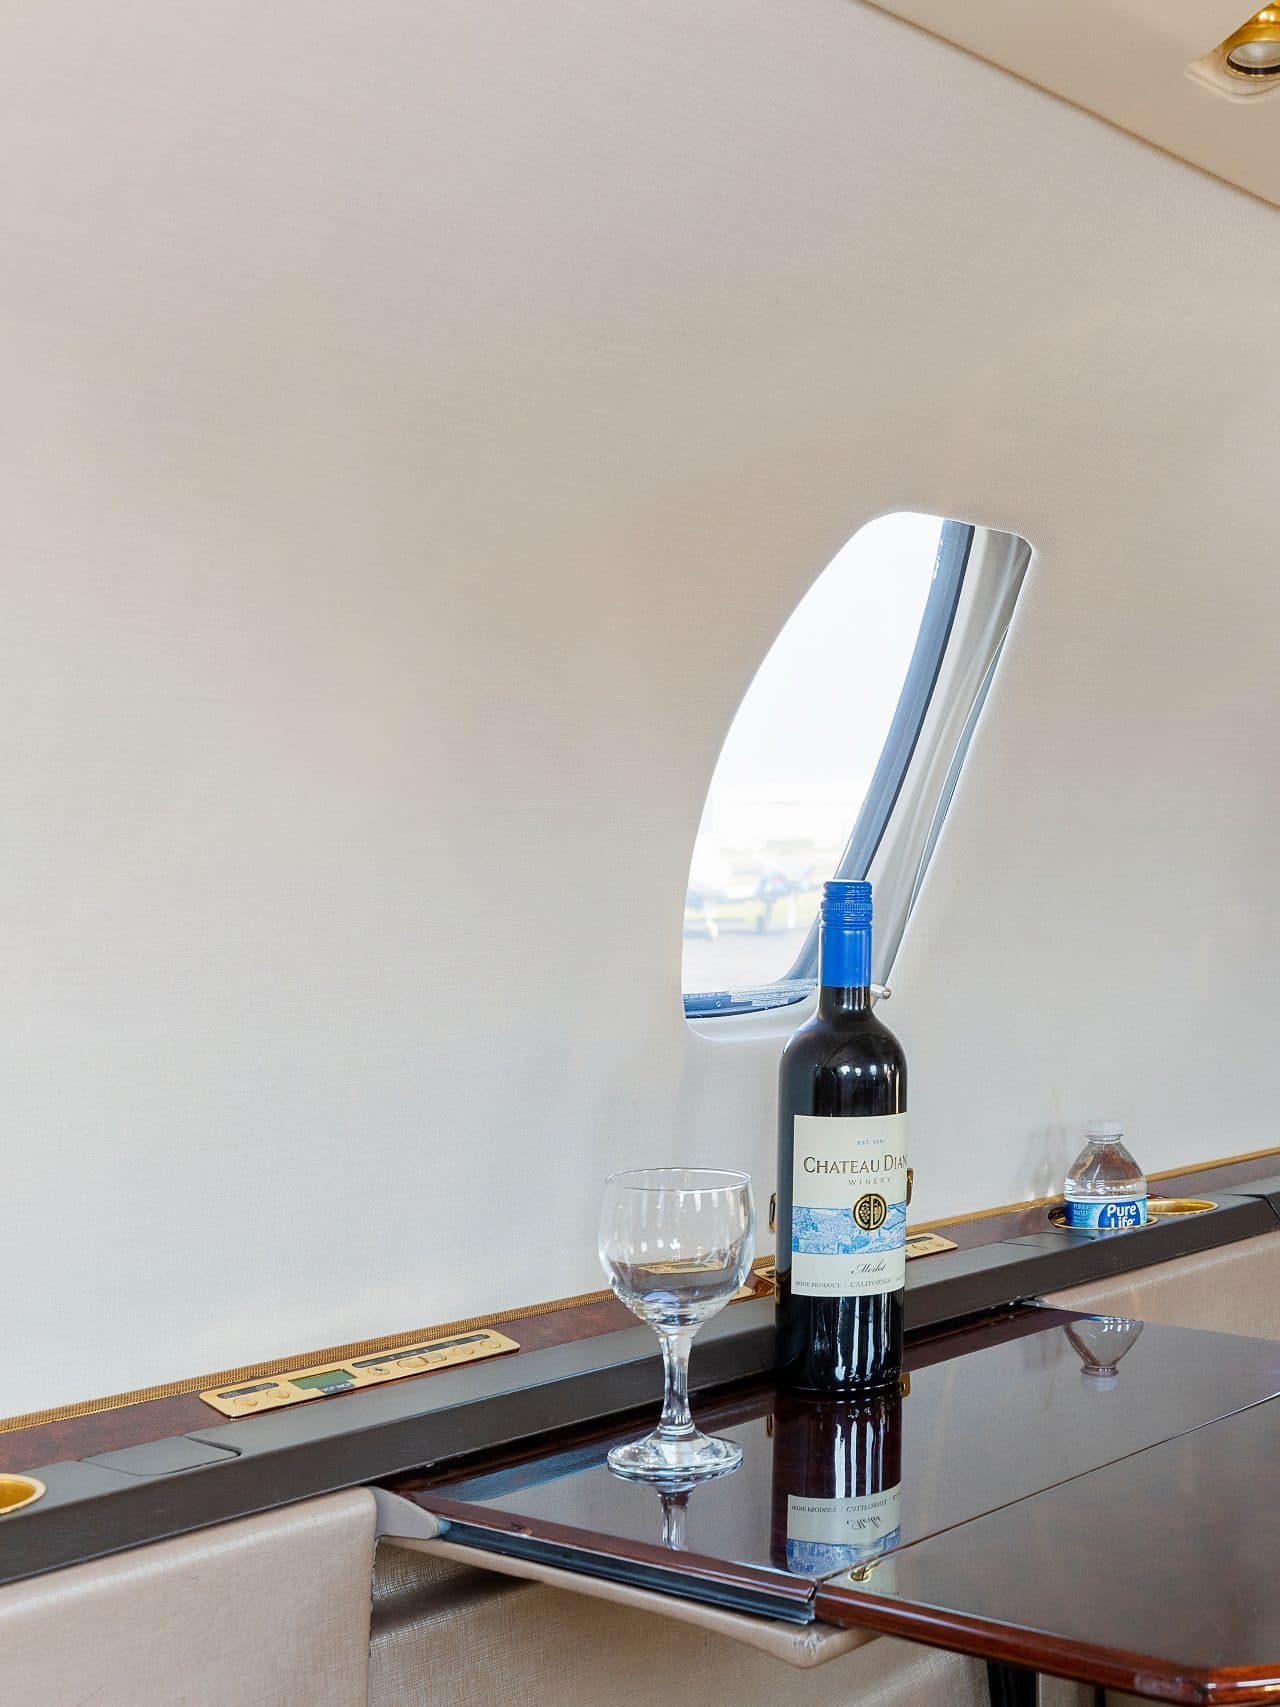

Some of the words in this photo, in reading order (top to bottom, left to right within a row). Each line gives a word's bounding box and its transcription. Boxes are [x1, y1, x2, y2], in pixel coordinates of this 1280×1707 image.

[803, 1156, 880, 1174] CHATEAU
[848, 1177, 892, 1186] WINERY
[1107, 1204, 1137, 1217] Pure
[1110, 1216, 1134, 1228] Life
[850, 1259, 887, 1274] Merlot
[811, 1281, 841, 1289] PRODUCT
[850, 1278, 892, 1288] CALIFORNIA
